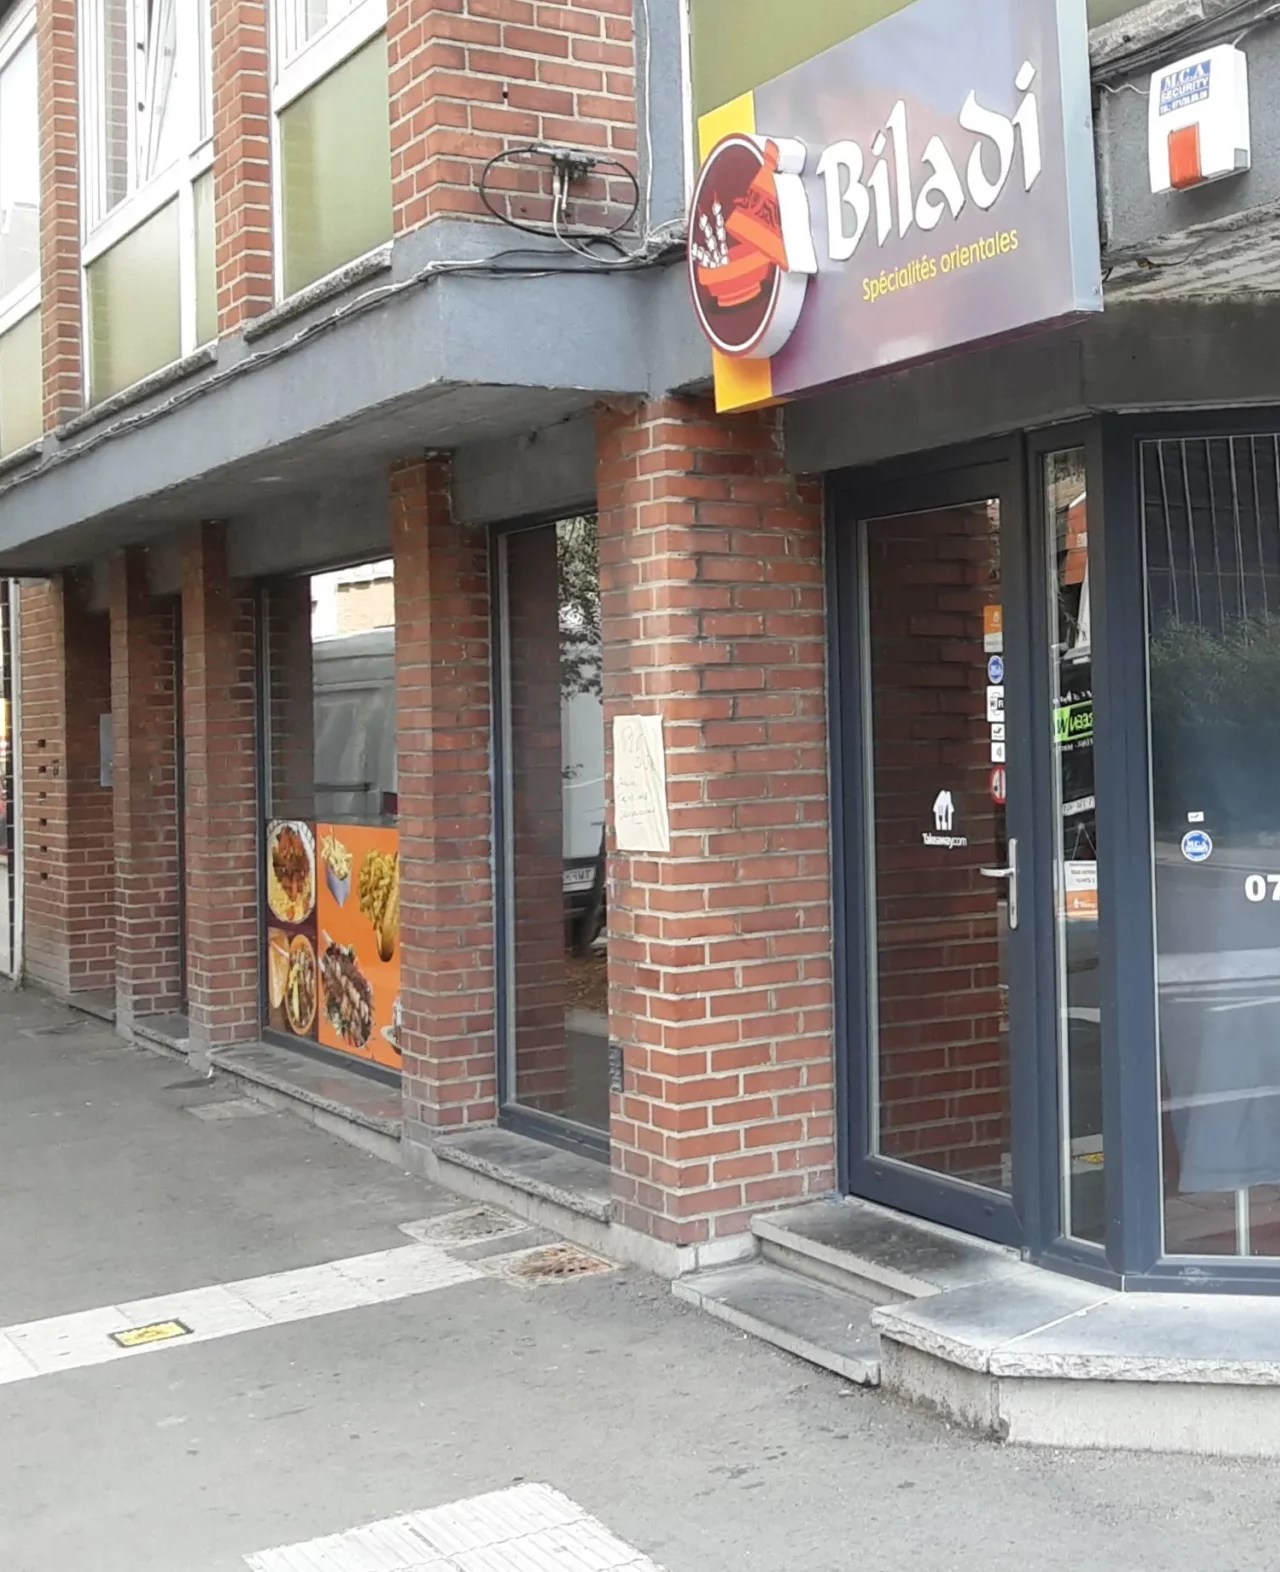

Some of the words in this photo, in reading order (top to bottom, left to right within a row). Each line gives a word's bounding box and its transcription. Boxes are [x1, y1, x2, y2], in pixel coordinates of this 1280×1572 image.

[1161, 76, 1209, 100] SECURITY
[816, 60, 1041, 261] Biladi
[862, 254, 937, 302] Spécialités
[941, 228, 1019, 273] orientales
